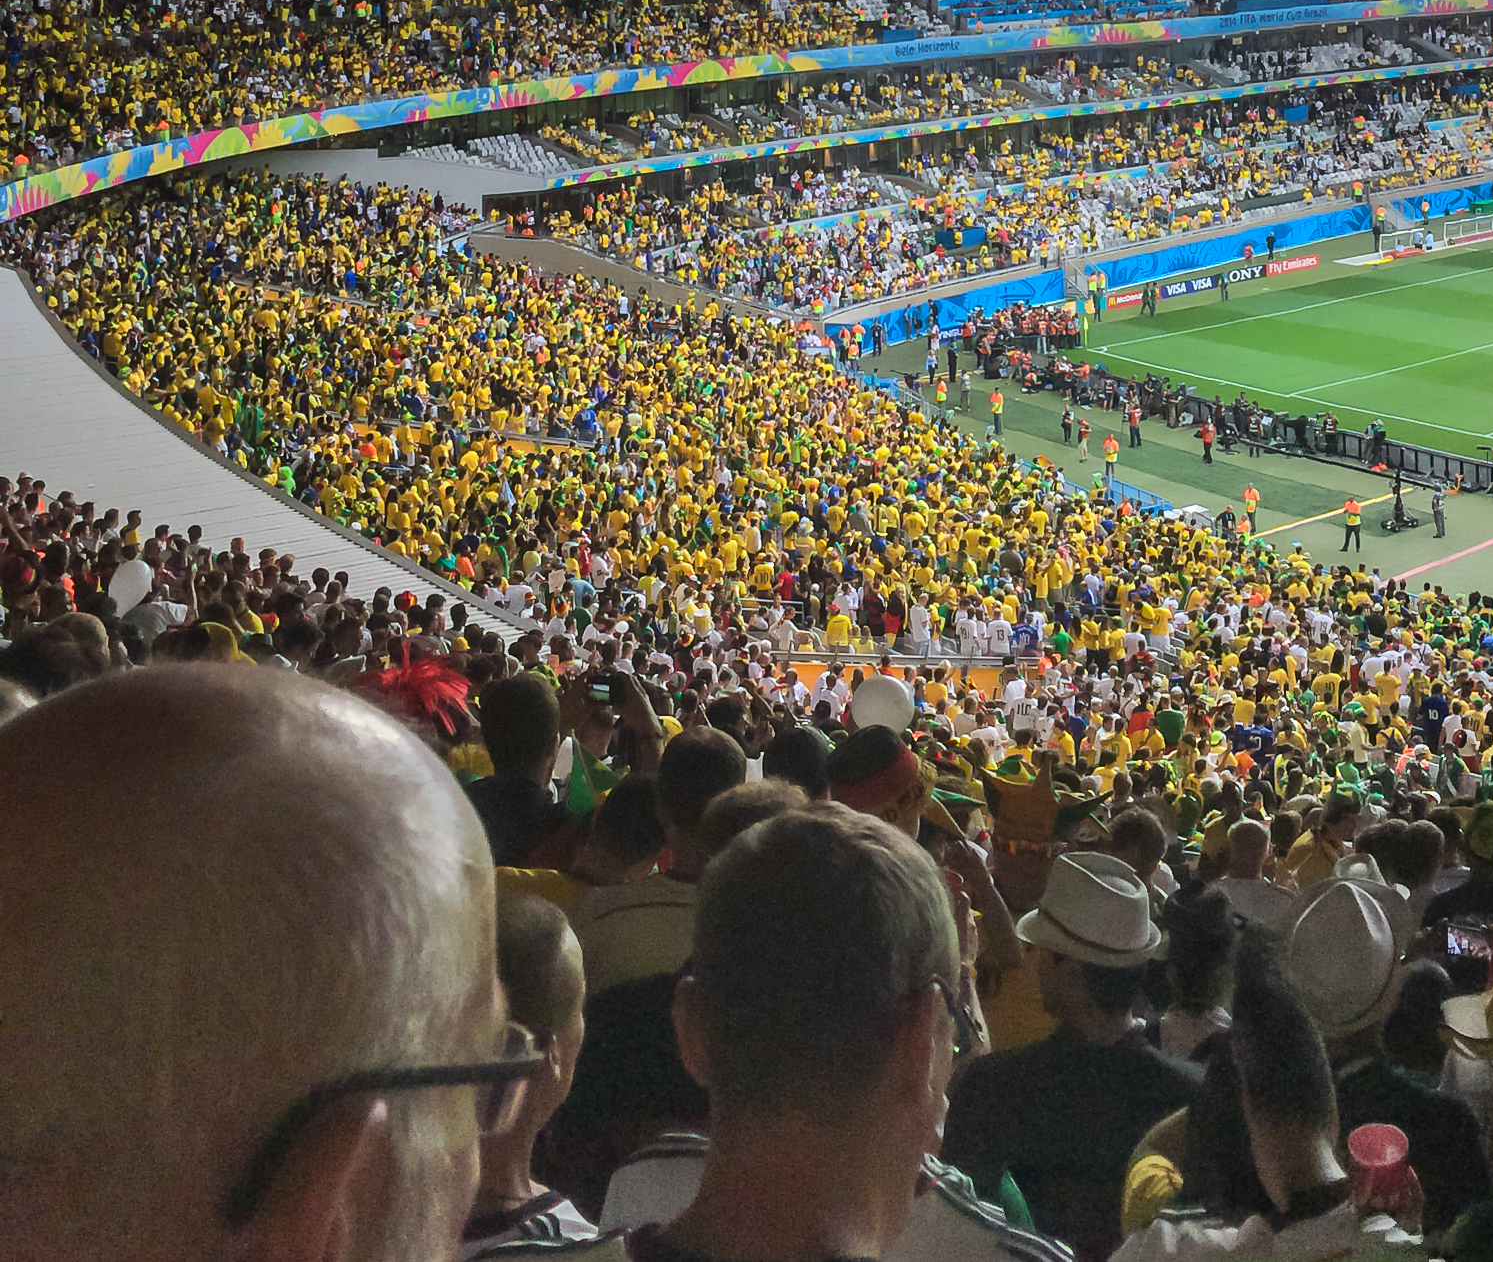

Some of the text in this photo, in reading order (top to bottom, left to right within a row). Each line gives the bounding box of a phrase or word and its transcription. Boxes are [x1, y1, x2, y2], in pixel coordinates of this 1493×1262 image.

[1219, 17, 1237, 28] 2014
[1240, 13, 1257, 25] FIFA
[1259, 12, 1284, 23] World
[1286, 10, 1302, 21] Cup
[895, 39, 960, 57] Belo Horizonte
[1269, 256, 1317, 275] Fly Emirates
[1228, 265, 1263, 284] ONY
[1166, 282, 1187, 296] VISA
[1191, 276, 1213, 291] VISA
[997, 628, 1006, 642] 13
[1428, 709, 1439, 720] 10
